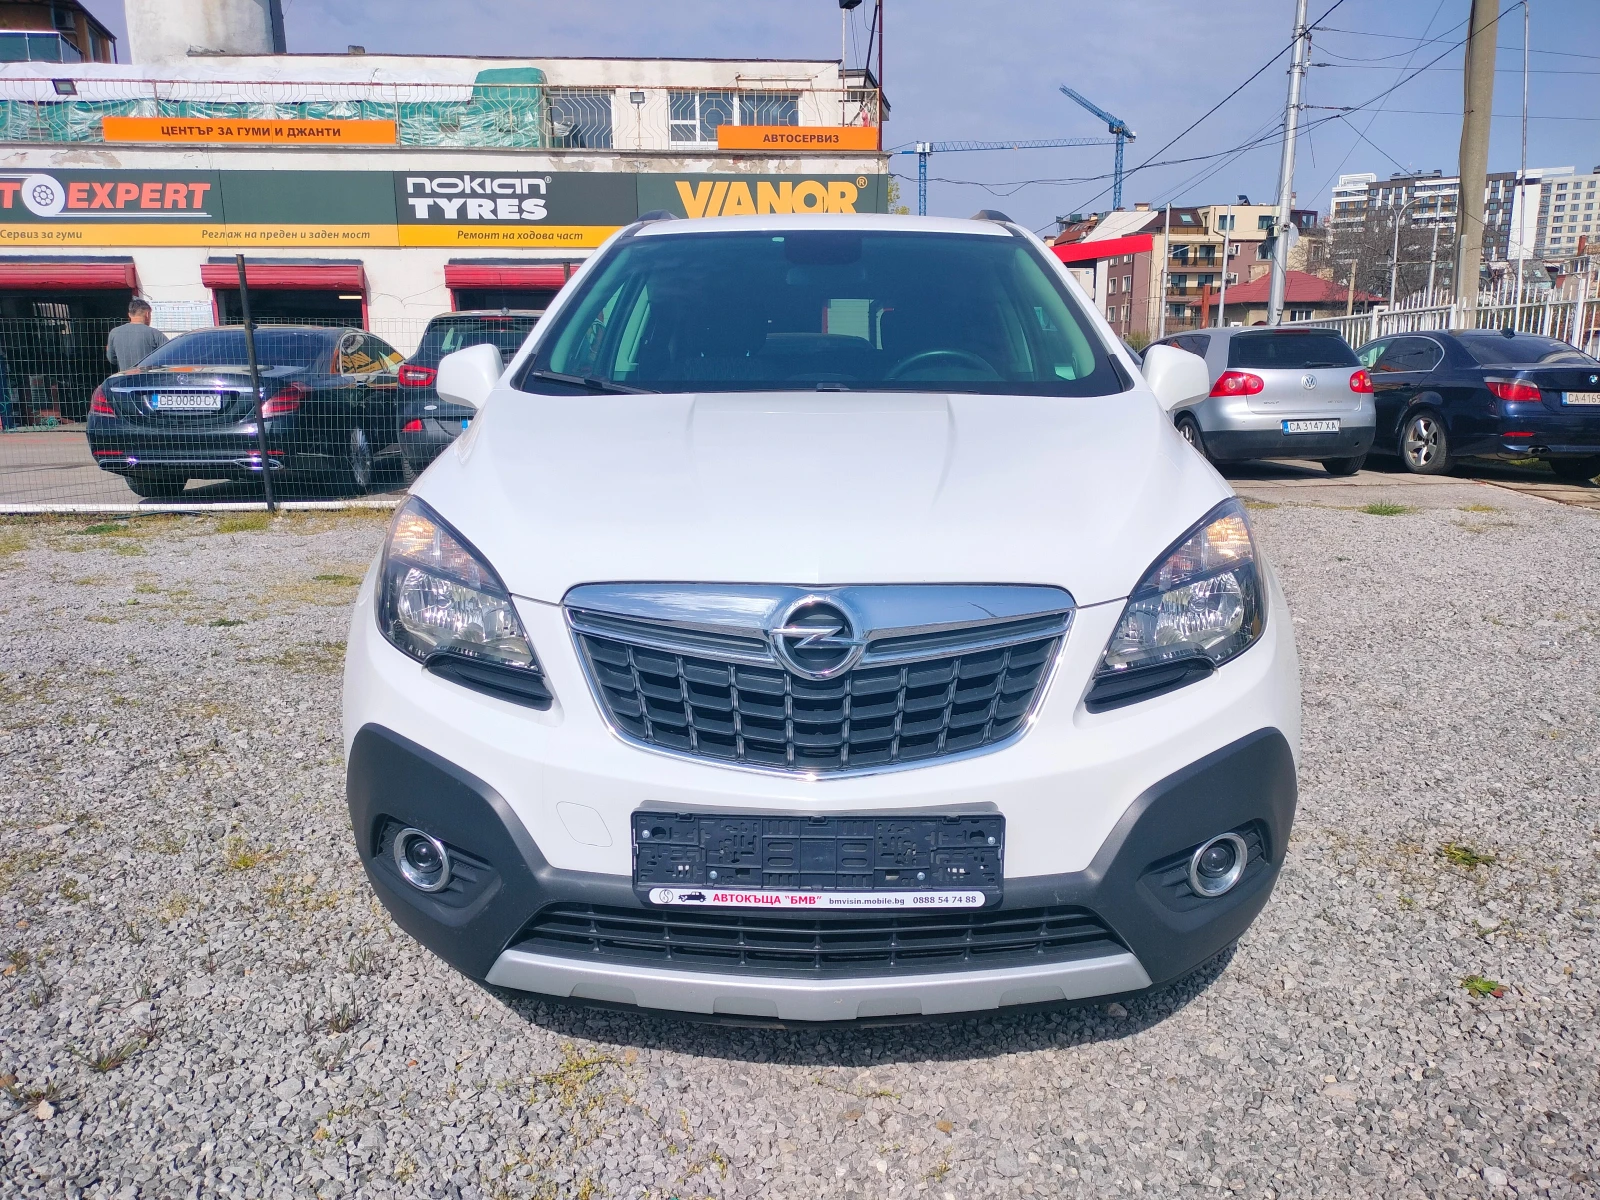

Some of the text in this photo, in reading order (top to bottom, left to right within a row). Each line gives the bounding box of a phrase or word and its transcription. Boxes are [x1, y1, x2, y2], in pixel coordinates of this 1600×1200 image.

[161, 126, 341, 137] ЦЕНТЪР ЗА ГУМИ И ДЖАНТИ
[763, 134, 840, 143] АВТОСЕРВИЗ
[67, 182, 211, 209] EXPERT
[408, 197, 548, 220] TYRES
[0, 229, 83, 241] Сервиз за гуми
[202, 230, 242, 239] Реглаж
[260, 229, 298, 241] преден
[309, 230, 339, 239] заден
[457, 230, 583, 240] Ремонт на ходова част
[176, 395, 202, 406] 0080
[1303, 421, 1323, 431] 3147
[713, 893, 781, 906] АВТОКЪЩА
[829, 897, 905, 906] bmvisin.mobile.bg
[912, 896, 935, 904] 0888
[938, 896, 949, 904] 54
[951, 896, 963, 904] 74
